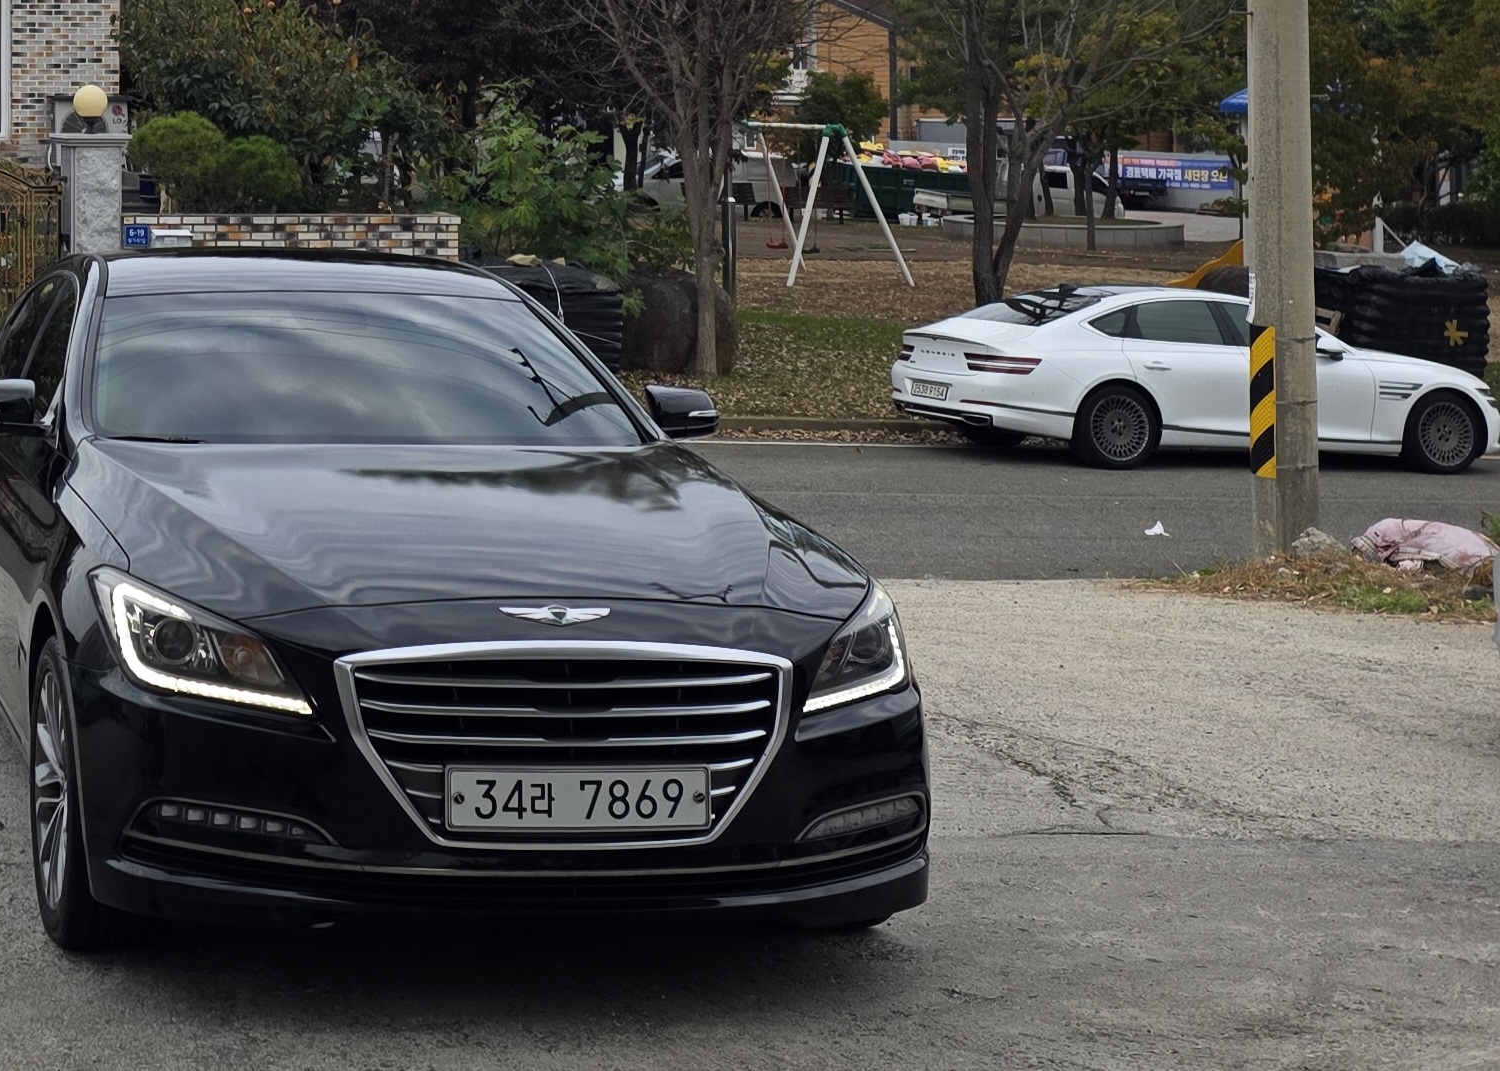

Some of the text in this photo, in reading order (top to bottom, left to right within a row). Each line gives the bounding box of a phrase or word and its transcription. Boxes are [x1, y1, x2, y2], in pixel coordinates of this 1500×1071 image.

[129, 228, 145, 237] 6-19
[474, 778, 684, 820] 34라 7869
